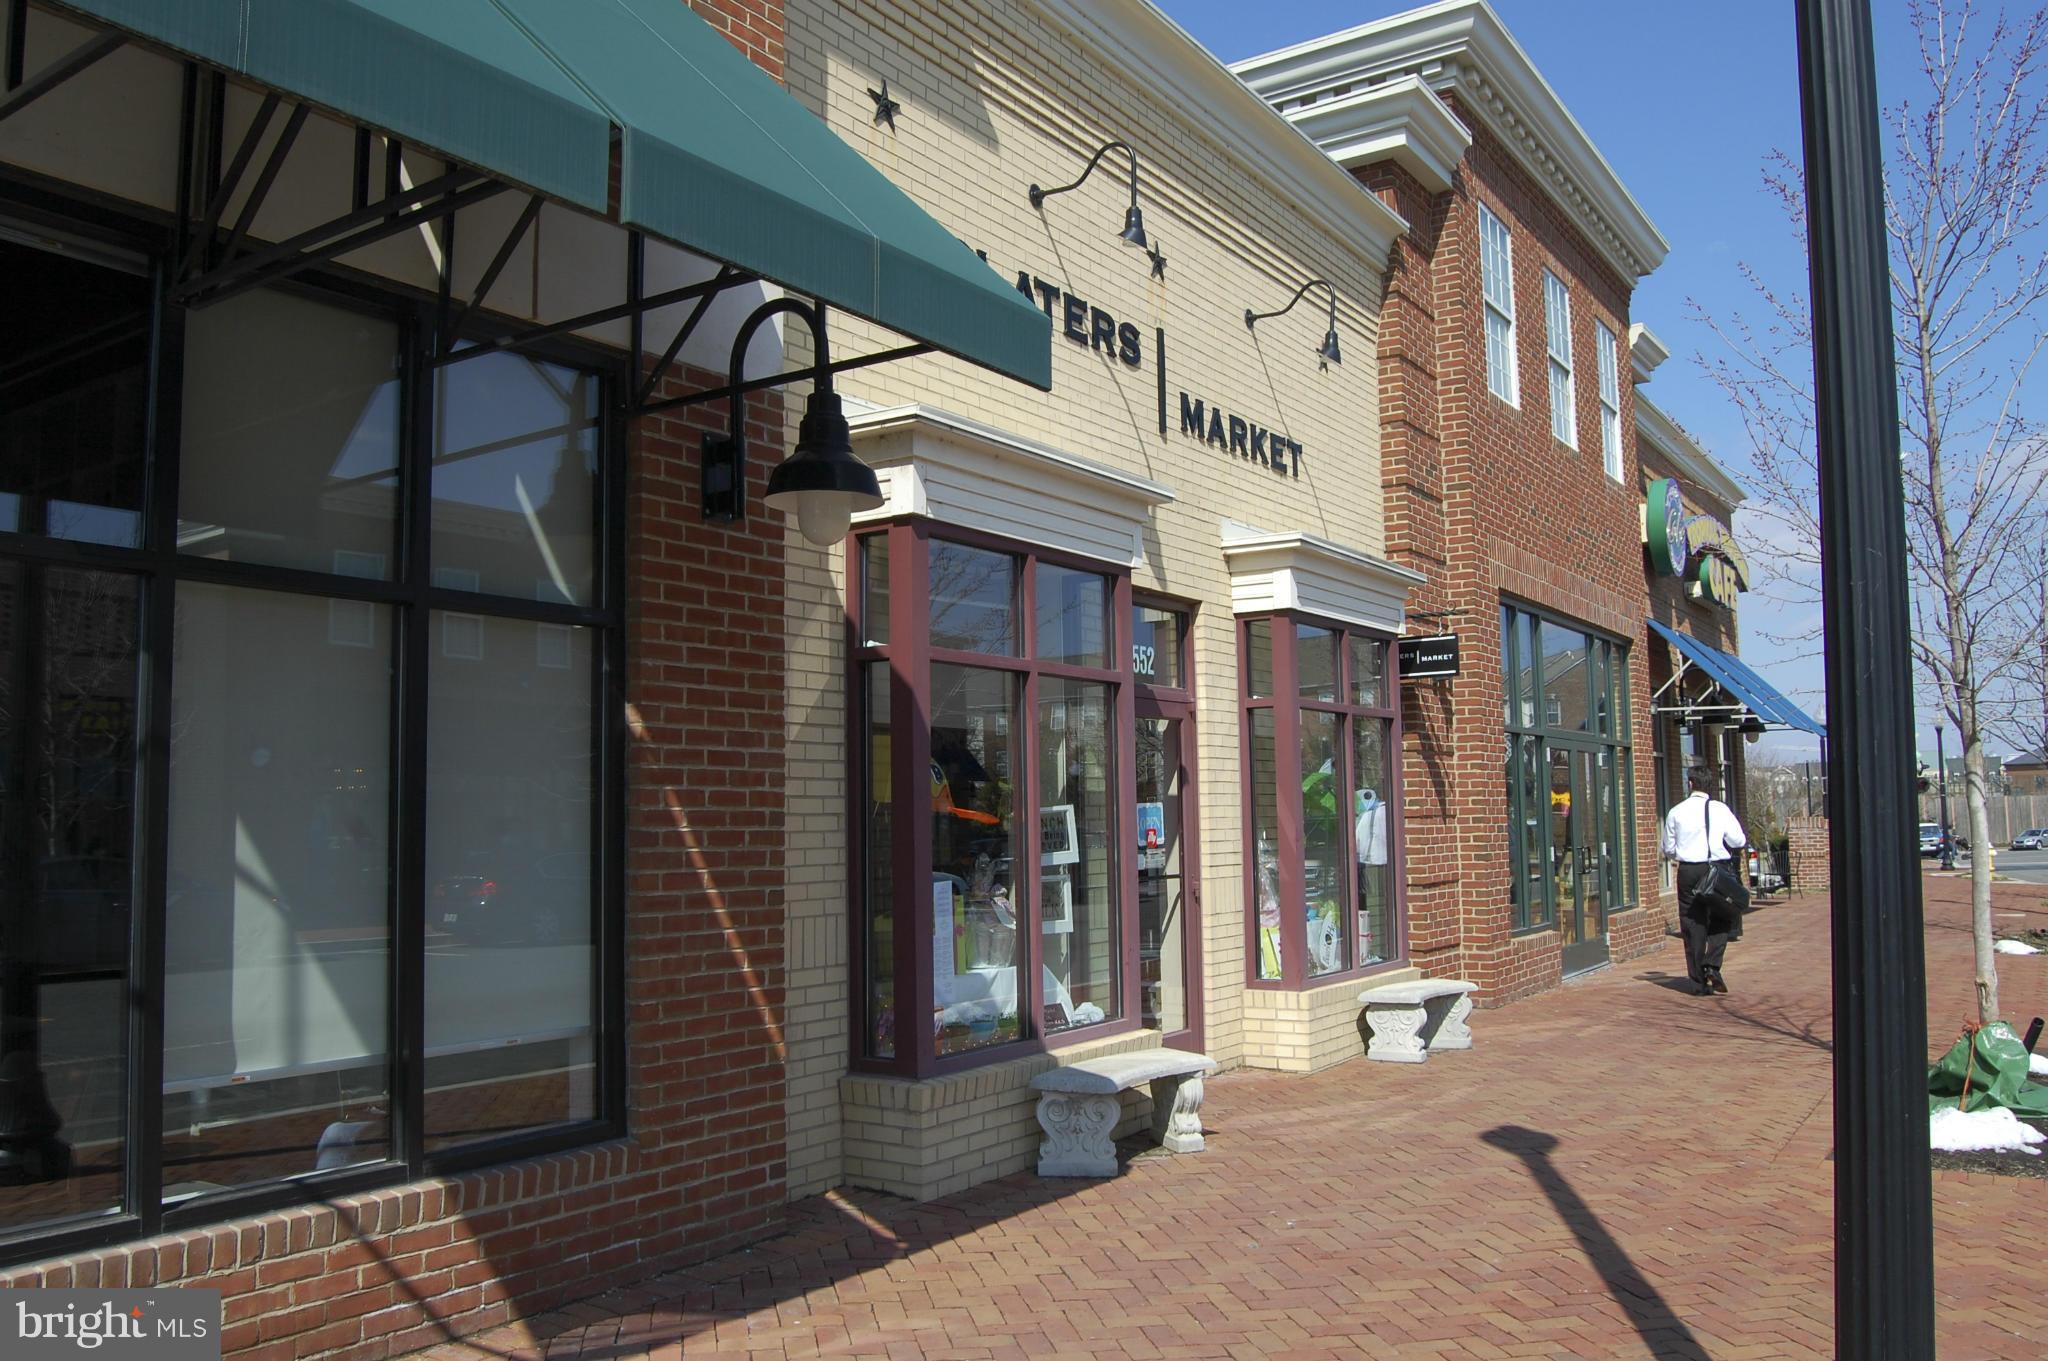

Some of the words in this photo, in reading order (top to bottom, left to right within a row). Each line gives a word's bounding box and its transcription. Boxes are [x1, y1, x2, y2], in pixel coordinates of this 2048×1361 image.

[1179, 391, 1303, 478] MARKET
[1133, 645, 1155, 676] 552
[1421, 653, 1454, 662] MARKET
